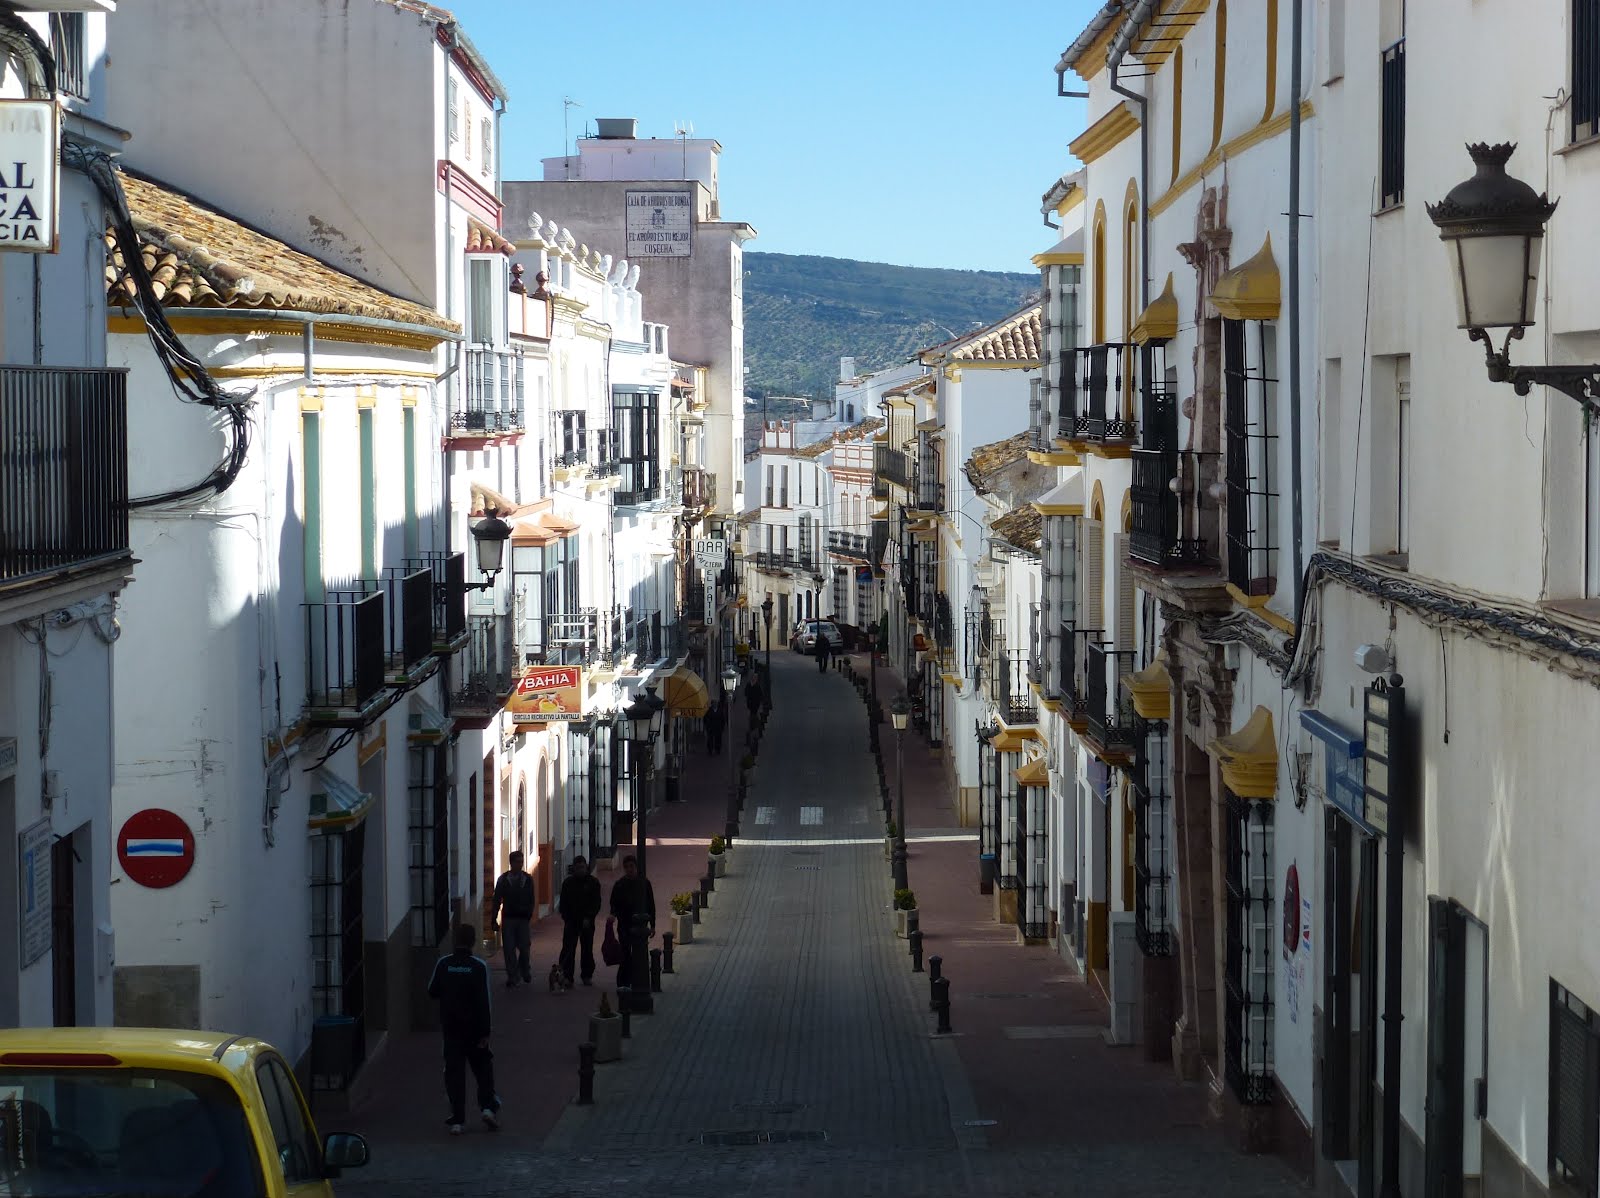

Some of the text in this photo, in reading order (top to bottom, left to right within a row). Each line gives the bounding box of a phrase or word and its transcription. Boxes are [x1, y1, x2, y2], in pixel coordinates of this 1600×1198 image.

[628, 196, 640, 206] CAJA
[640, 196, 647, 206] DE
[674, 196, 690, 206] RONDA
[629, 233, 635, 241] EL
[657, 233, 664, 241] ES
[665, 233, 672, 241] TU
[672, 232, 689, 241] MEJOR
[697, 541, 723, 553] BAR
[696, 553, 723, 568] CAFETERIA
[706, 569, 713, 582] EL
[525, 673, 570, 689] BAHIA
[680, 708, 697, 717] BAR
